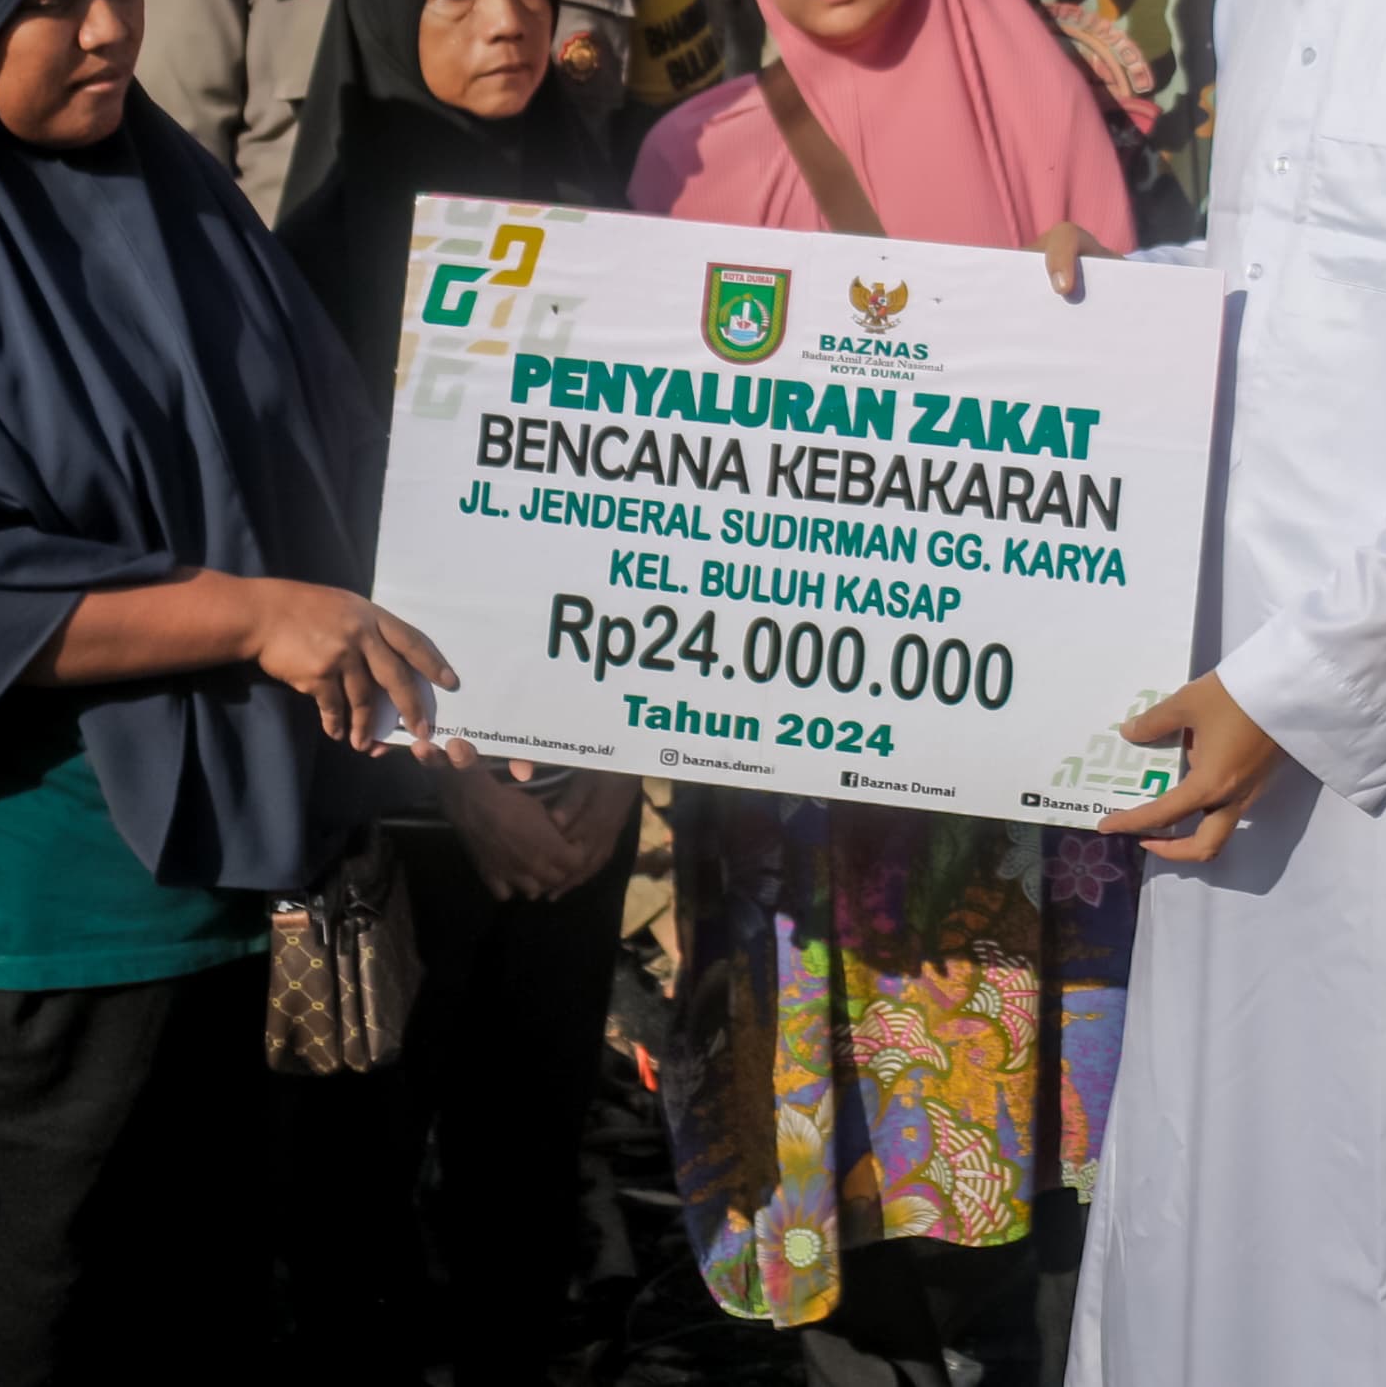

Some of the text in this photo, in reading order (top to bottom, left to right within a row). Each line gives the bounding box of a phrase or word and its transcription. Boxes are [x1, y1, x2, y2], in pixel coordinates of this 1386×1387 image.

[801, 350, 944, 372] Badan Amil Zakat Nasional
[819, 334, 929, 361] BAZNAS
[830, 364, 915, 381] KOTA DUMAI
[510, 352, 1101, 461] PENYALURAN ZAKAT
[476, 413, 1122, 532] BENCANA KEBAKARAN
[459, 479, 1127, 587] JL. JENDERAL SUDIRMAN GG. KARYA
[609, 549, 963, 624] KEL. BULUH KASAP
[547, 593, 1014, 711] Rp24.000.000
[428, 725, 615, 757] tps://kotadumai.baznas.go.id/
[623, 693, 895, 758] Tahun 2024
[682, 752, 775, 775] baznas.dumai
[860, 775, 956, 798] Baznas Dumai
[1042, 796, 1090, 813] Baznas
